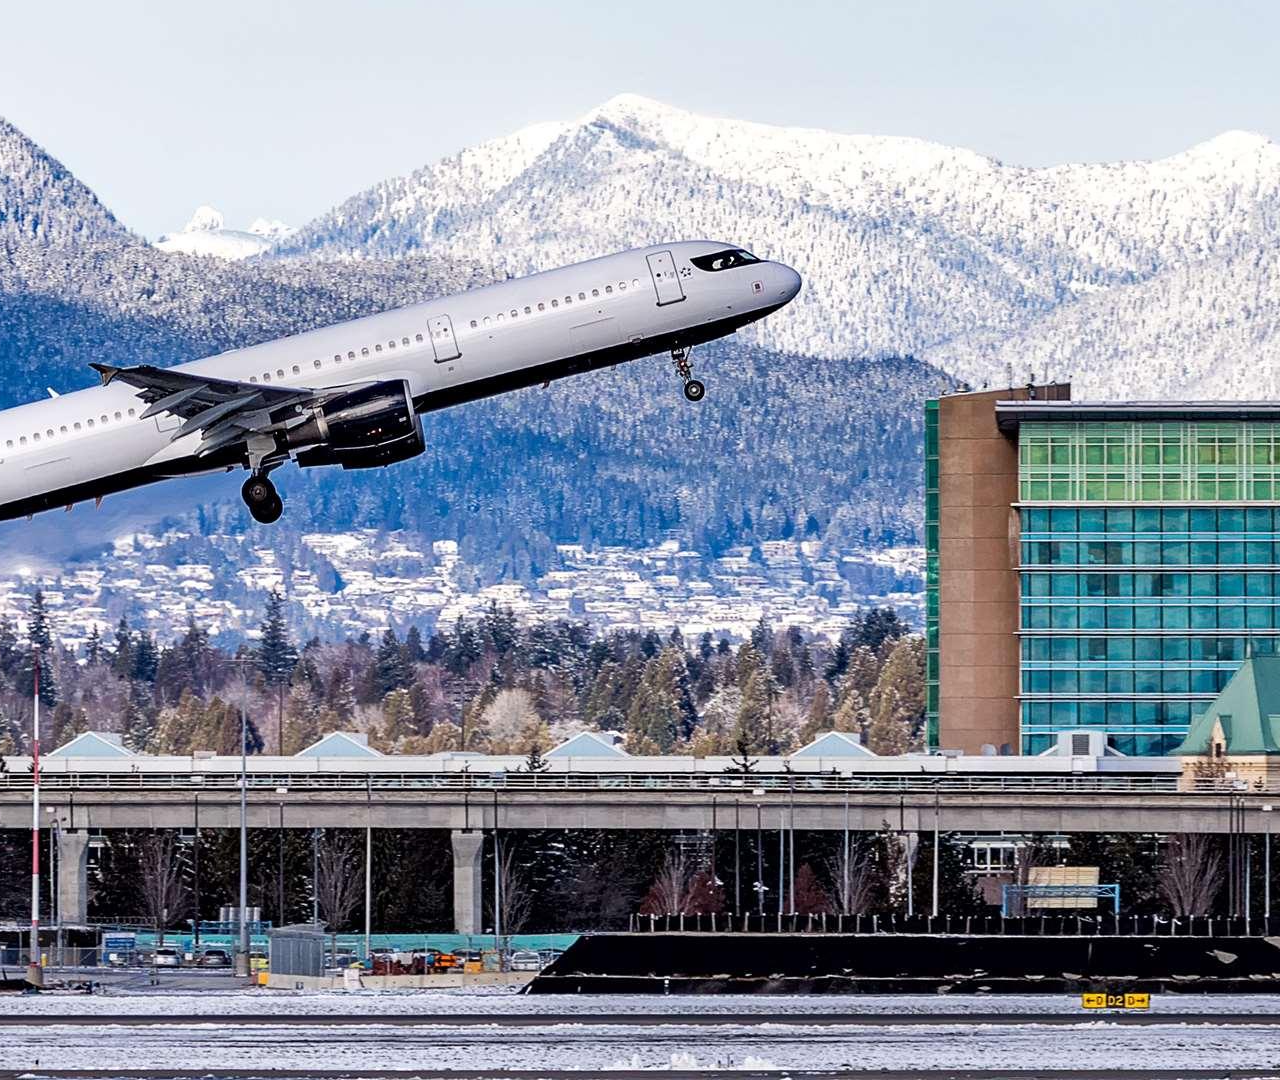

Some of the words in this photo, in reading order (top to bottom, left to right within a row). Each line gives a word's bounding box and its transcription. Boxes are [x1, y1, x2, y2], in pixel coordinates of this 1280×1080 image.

[1096, 996, 1104, 1006] D
[1108, 995, 1124, 1006] D2
[1127, 996, 1136, 1006] D
